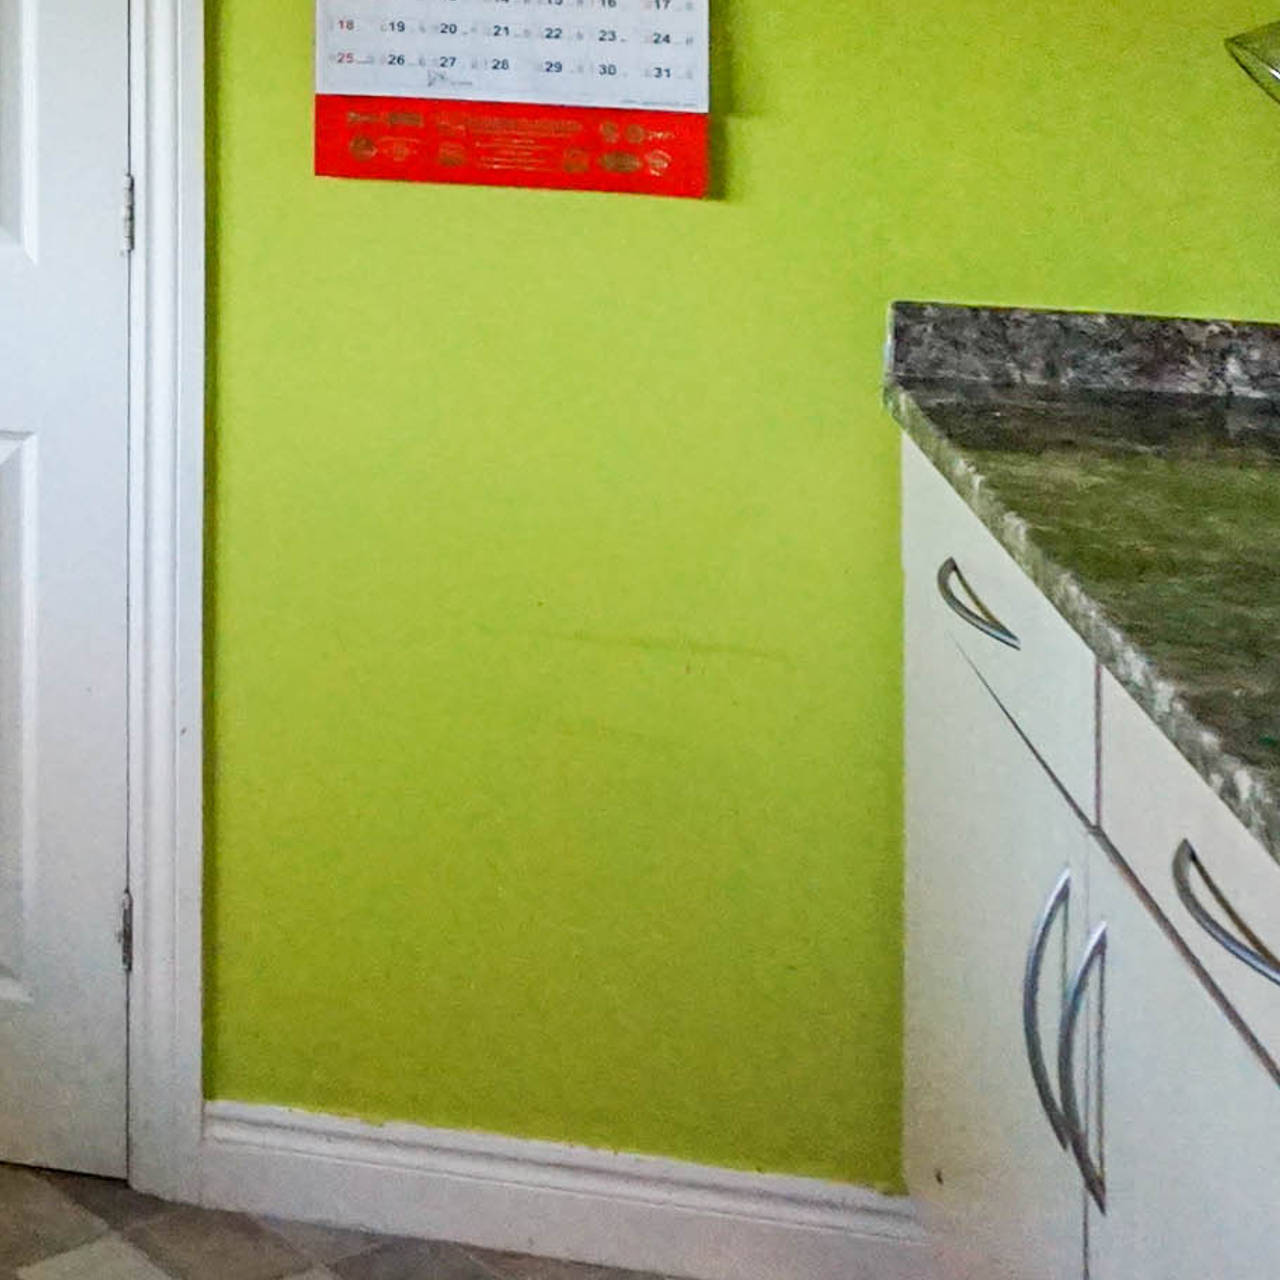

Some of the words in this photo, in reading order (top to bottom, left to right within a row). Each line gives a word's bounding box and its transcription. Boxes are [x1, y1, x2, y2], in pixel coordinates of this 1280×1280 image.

[338, 20, 354, 30] 18
[389, 21, 405, 32] 19
[440, 23, 457, 34] 20
[493, 25, 509, 36] 21
[545, 28, 563, 39] 22
[598, 30, 617, 42] 23
[653, 32, 671, 44] 24
[337, 52, 354, 64] 25
[388, 54, 405, 65] 26
[440, 56, 456, 67] 27
[492, 58, 509, 70] 28
[545, 61, 563, 72] 29
[598, 64, 617, 76] 30
[654, 67, 672, 78] 31
